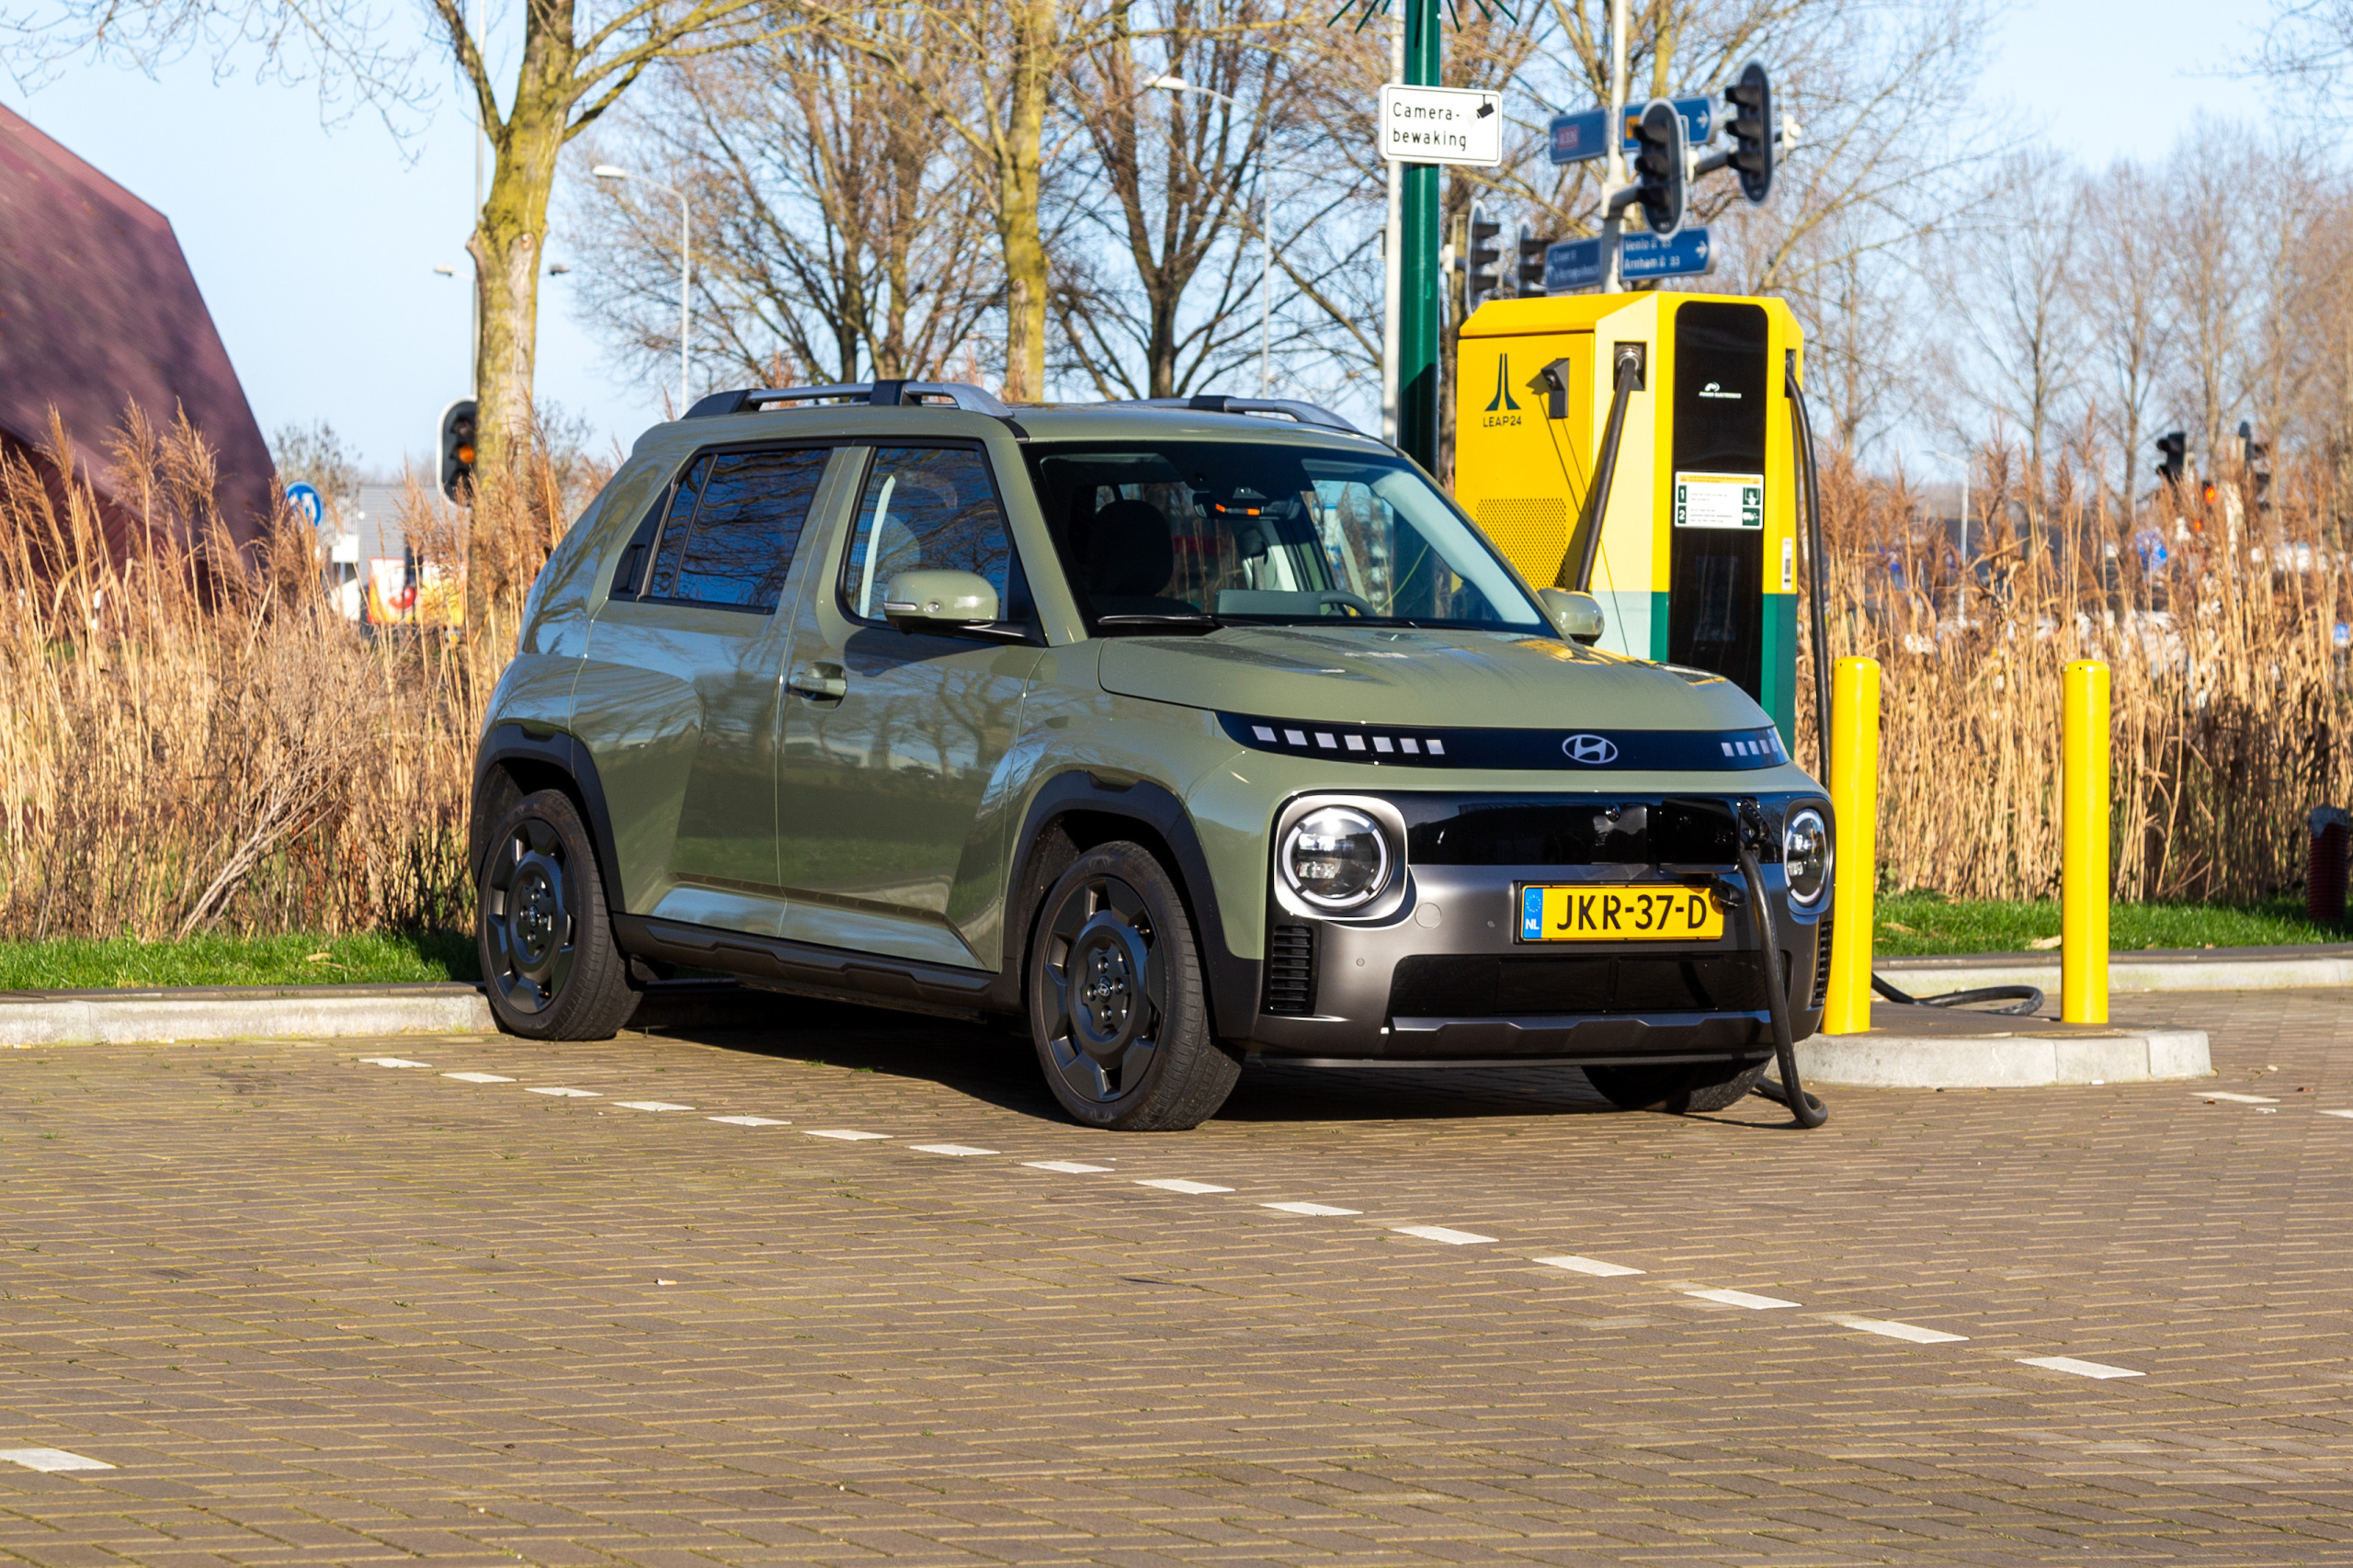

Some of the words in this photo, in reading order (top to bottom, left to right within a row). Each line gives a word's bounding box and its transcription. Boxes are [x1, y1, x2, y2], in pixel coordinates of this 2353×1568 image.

[1393, 102, 1460, 120] Camera-
[1393, 128, 1467, 151] bewaking
[1624, 256, 1657, 271] Arnhem
[1483, 415, 1522, 427] LEAP24
[1679, 489, 1686, 500] 1
[1678, 509, 1686, 520] 2
[1525, 918, 1540, 930] NL
[1556, 894, 1707, 930] JKR-37-D
